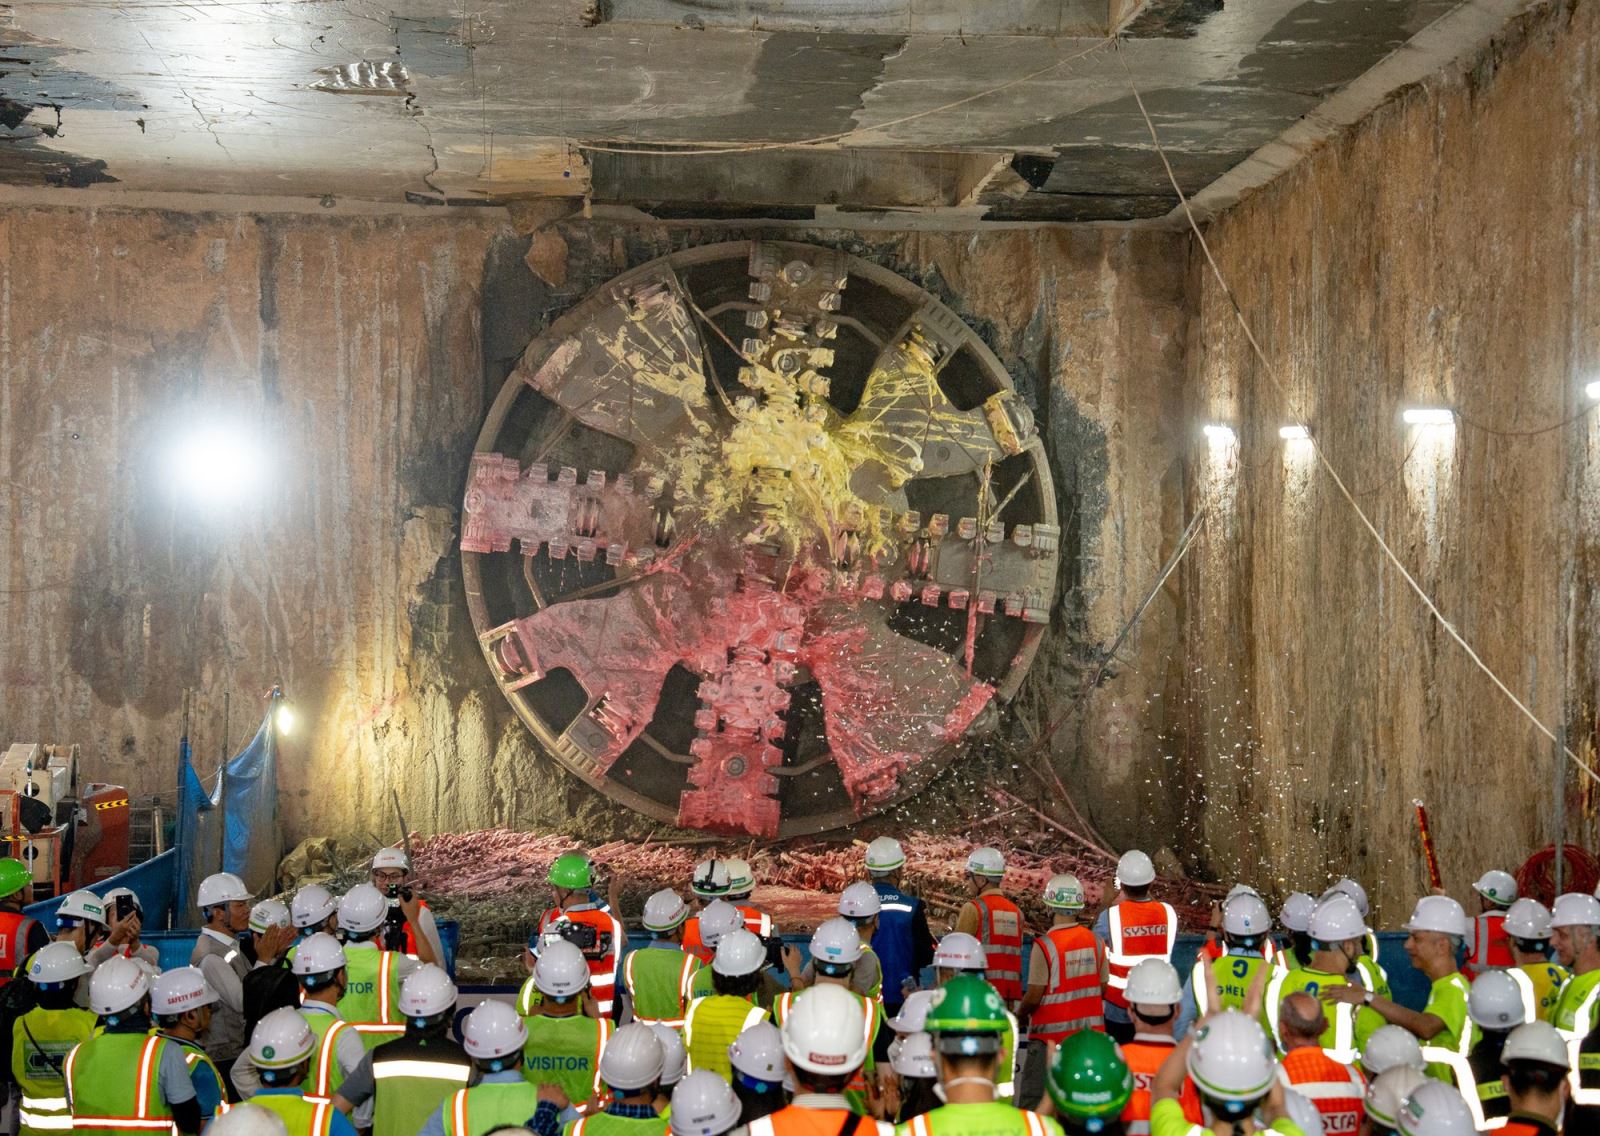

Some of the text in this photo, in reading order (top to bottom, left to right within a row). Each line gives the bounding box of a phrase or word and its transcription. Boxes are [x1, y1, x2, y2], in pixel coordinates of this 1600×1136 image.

[879, 894, 900, 902] LPRO
[1124, 925, 1168, 937] SYSTRA
[1216, 984, 1245, 997] GHEL
[167, 994, 189, 1005] SAFETY
[527, 1057, 588, 1071] VISITOR
[1321, 1113, 1356, 1131] STRA
